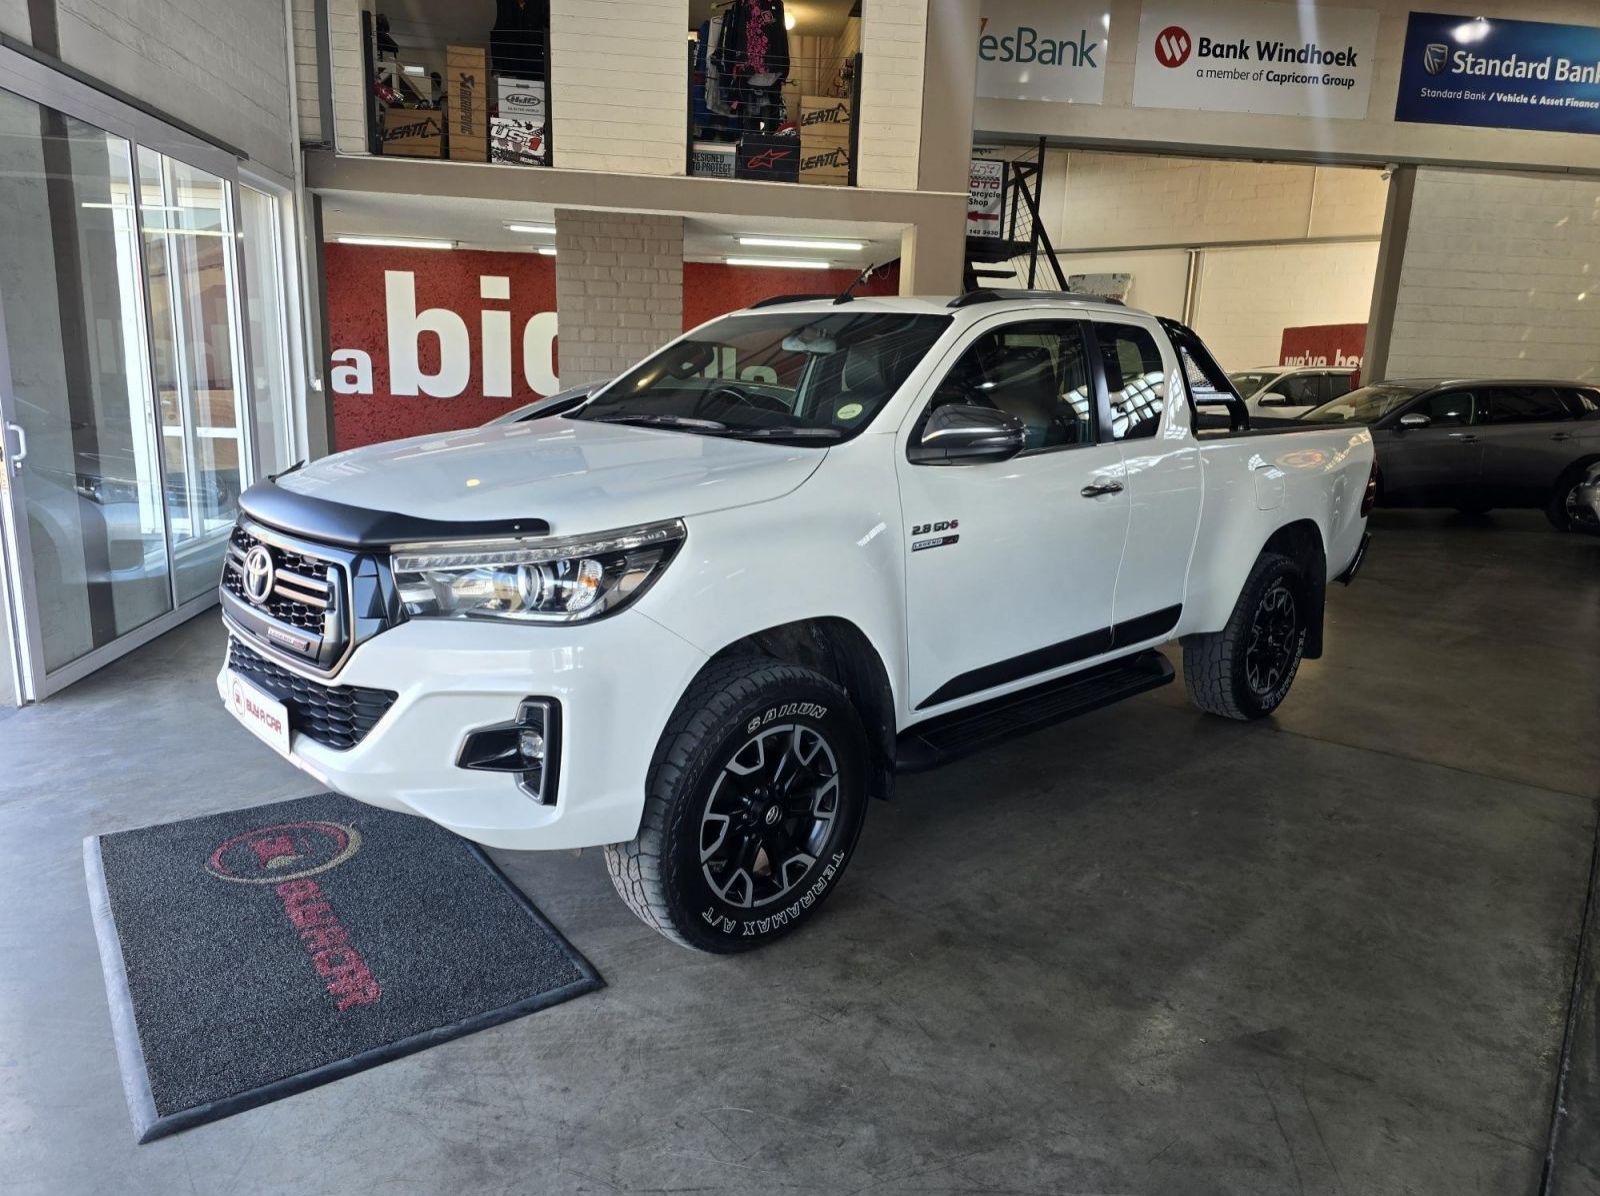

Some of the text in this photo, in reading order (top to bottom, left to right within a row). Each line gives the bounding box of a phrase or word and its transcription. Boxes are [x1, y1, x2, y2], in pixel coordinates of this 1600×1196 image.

[1198, 37, 1358, 67] Bank Windhoek
[1451, 50, 1552, 80] Standard
[1196, 68, 1355, 90] a member of Capricorn Group
[1421, 87, 1462, 99] Standard
[1463, 90, 1486, 101] Bank
[1496, 92, 1529, 104] Vehicle
[1529, 95, 1538, 105] &
[1539, 96, 1564, 107] Asset
[1565, 98, 1599, 109] Finance
[968, 198, 989, 207] Shop
[331, 348, 373, 395] a
[912, 524, 932, 535] 2.8
[747, 702, 827, 734] SAILUN
[703, 851, 845, 936] TERRAMAX A/T
